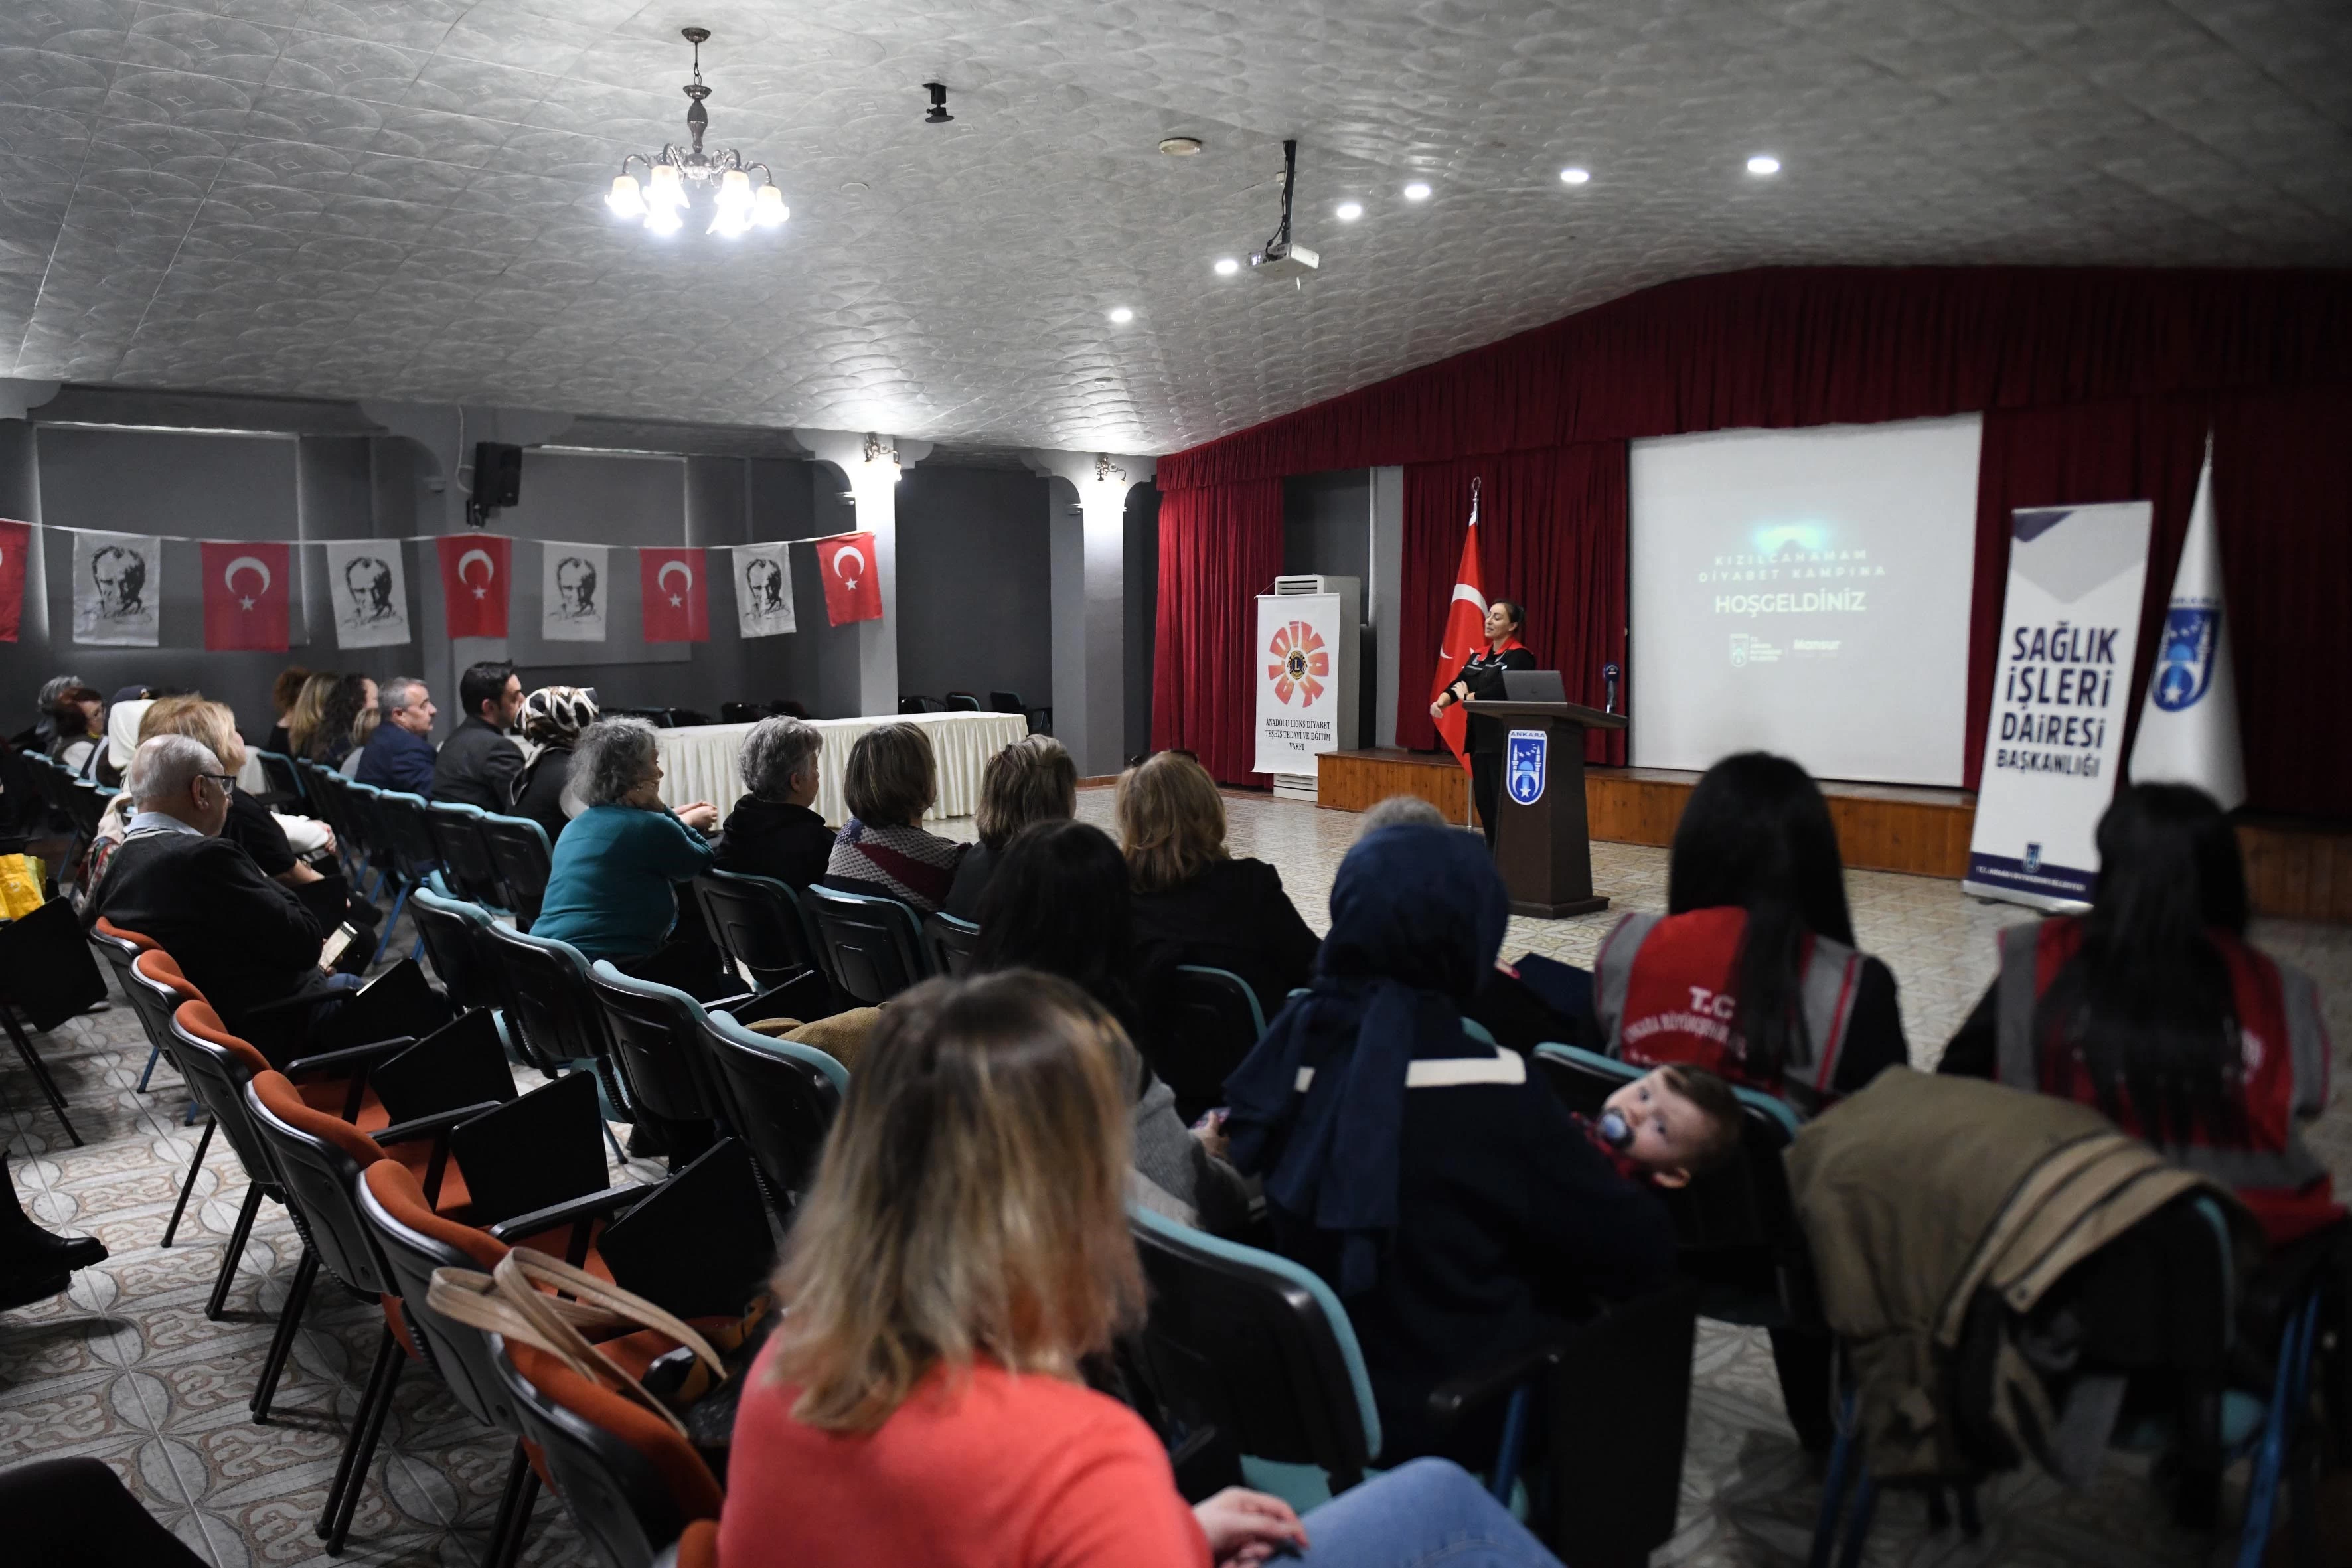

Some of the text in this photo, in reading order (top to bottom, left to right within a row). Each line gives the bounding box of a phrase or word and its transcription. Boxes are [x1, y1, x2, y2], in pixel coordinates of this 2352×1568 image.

[1715, 549, 1867, 566] KIZILCAHAMAM
[1699, 565, 1885, 583] DİYABET KAMPINA
[1715, 587, 1867, 617] HOŞGELDİNİZ
[2012, 621, 2119, 664] SAĞLIK
[2007, 666, 2112, 710] İŞLERİ
[1265, 728, 1283, 740] TEŞHİS
[1283, 730, 1302, 739] TEDAVİ
[1311, 731, 1330, 741] EĞİTİM
[1266, 718, 1330, 730] ANADOLU LİONS DİYABET
[2001, 712, 2105, 749] DAİRESİ
[1289, 742, 1304, 751] VAKFI
[1997, 748, 2100, 778] BAŞKANLIĞI
